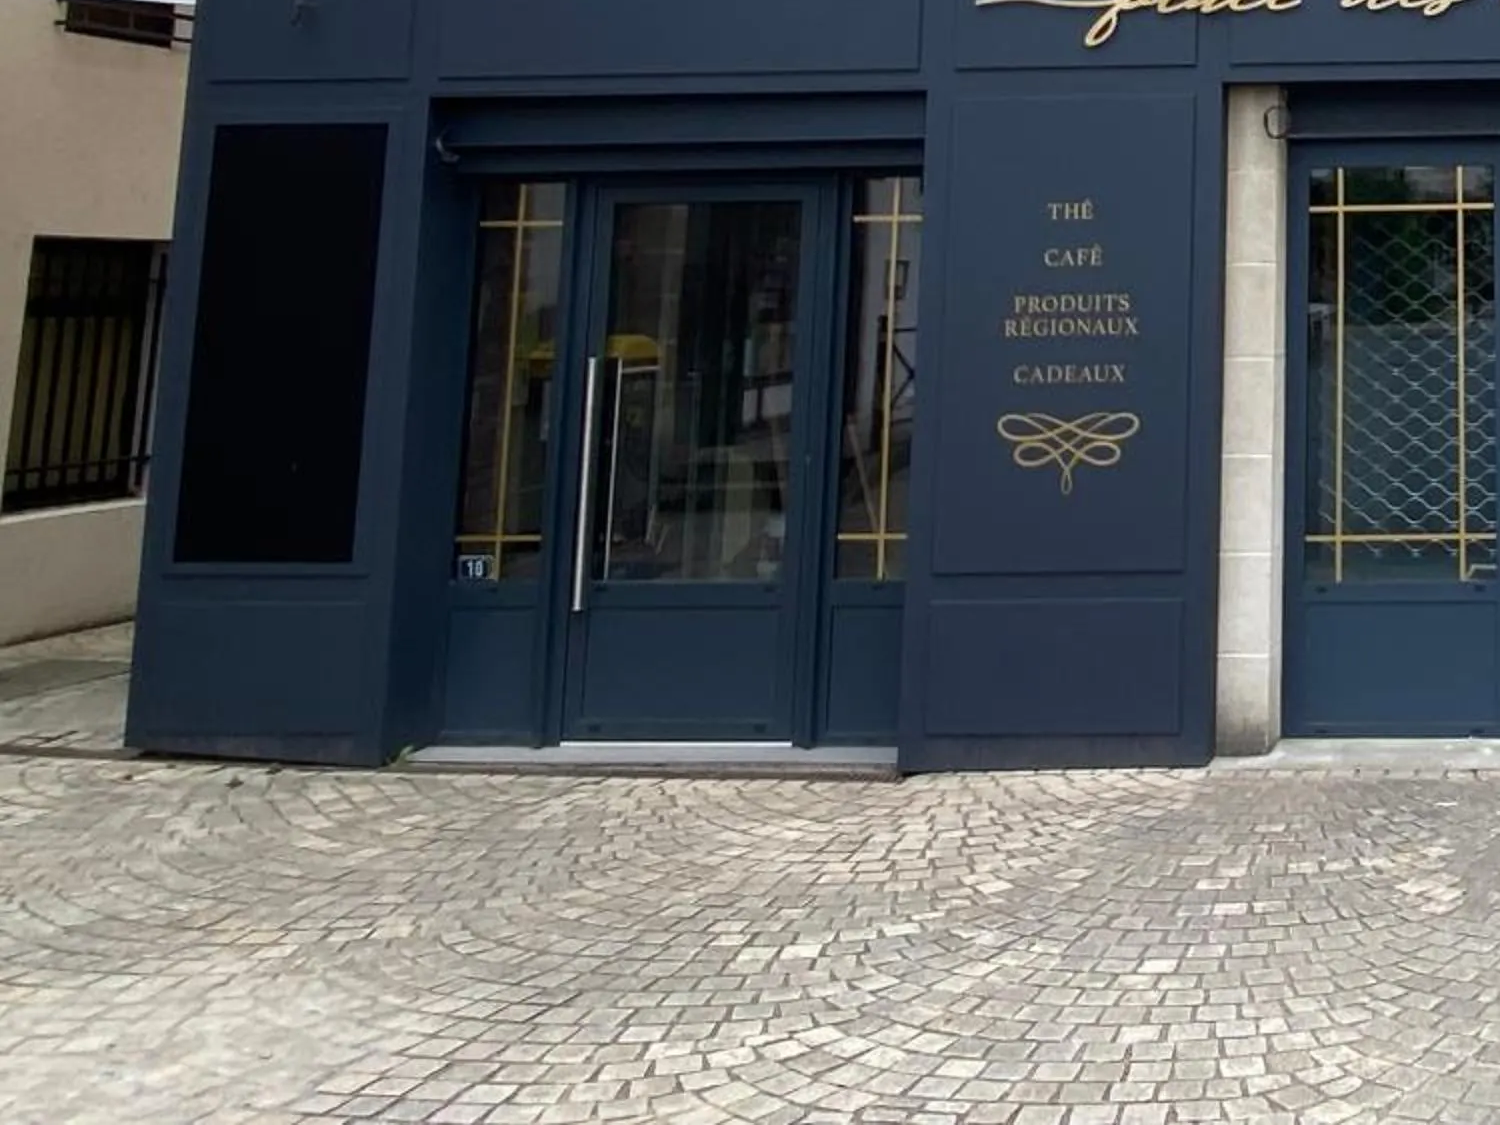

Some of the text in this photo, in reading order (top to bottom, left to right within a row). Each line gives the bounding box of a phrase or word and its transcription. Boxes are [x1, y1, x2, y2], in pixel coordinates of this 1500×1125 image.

[1047, 198, 1094, 220] THÉ
[1043, 244, 1103, 267] CAFÉ
[1013, 293, 1131, 314] PRODUITS
[1004, 316, 1140, 338] RÉGIONAUX
[1013, 365, 1126, 384] CADEAUX
